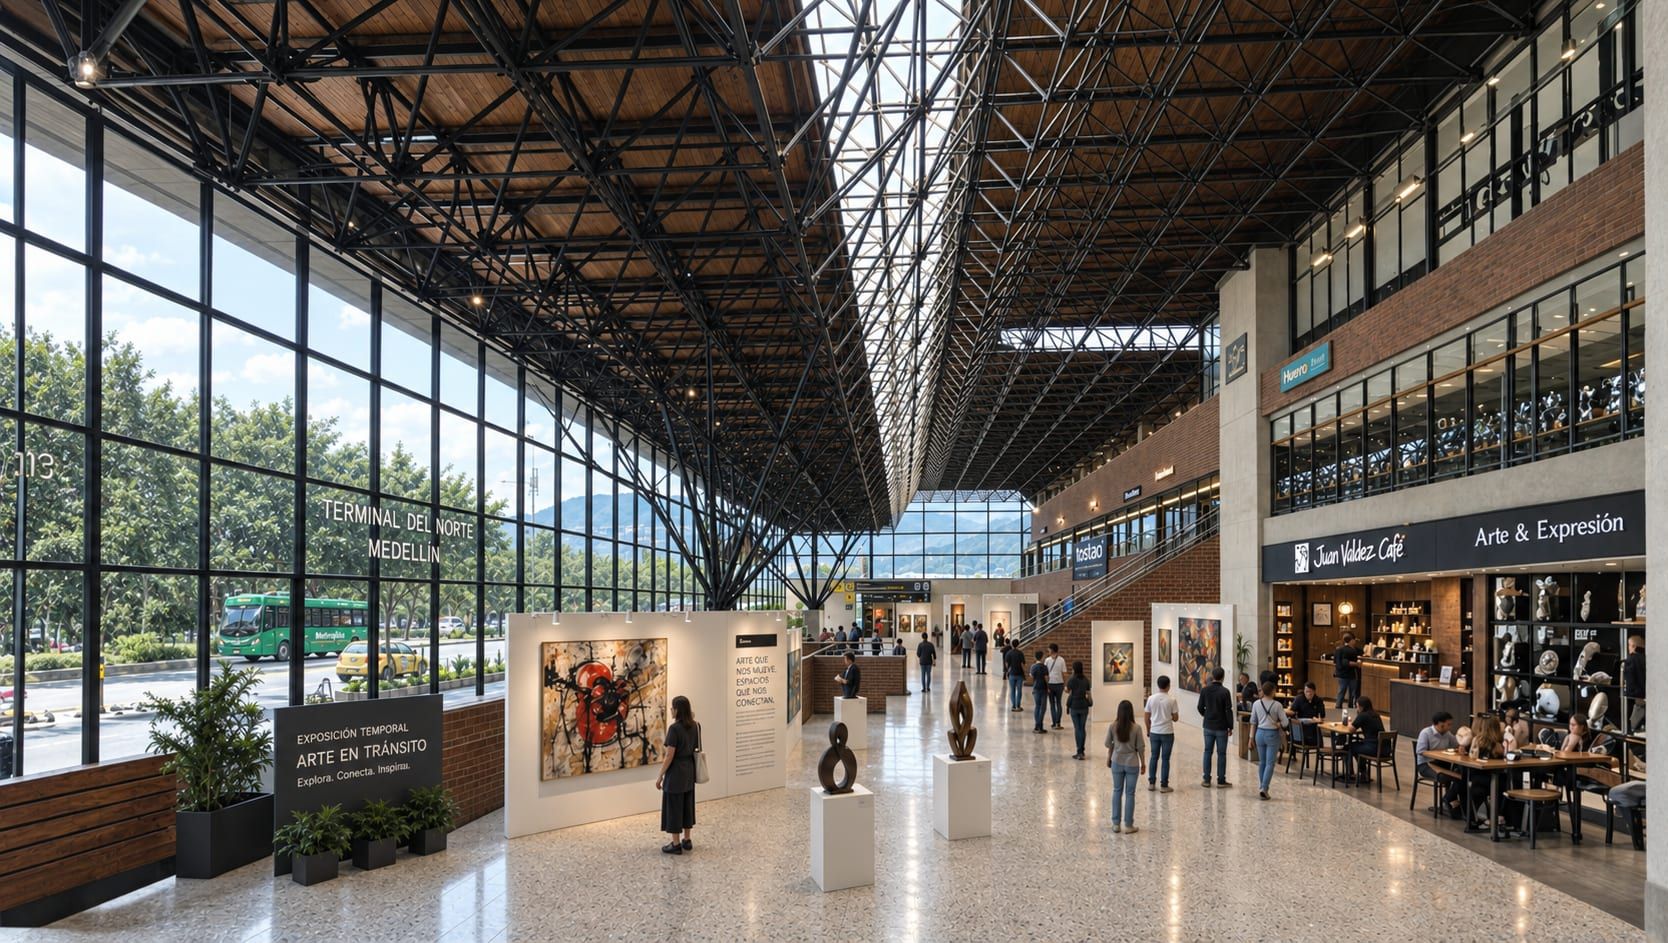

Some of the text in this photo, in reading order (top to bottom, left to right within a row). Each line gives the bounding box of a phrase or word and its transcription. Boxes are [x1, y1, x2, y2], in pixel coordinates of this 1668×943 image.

[322, 499, 473, 540] TERMINAL DEL NORTE
[1475, 513, 1624, 547] Arte & Expresión
[368, 538, 440, 563] MEDELLÍN
[1313, 544, 1339, 568] Juan
[1341, 538, 1376, 567] Valdez
[736, 656, 753, 665] ARTE
[736, 667, 751, 676] NOS
[752, 686, 767, 695] NOS
[297, 723, 409, 745] EXPOSICIÓN TEMPORAL
[296, 739, 427, 769] ARTE EN TRÁNSITO
[297, 774, 334, 788] Explora.
[337, 767, 375, 781] Conecta.
